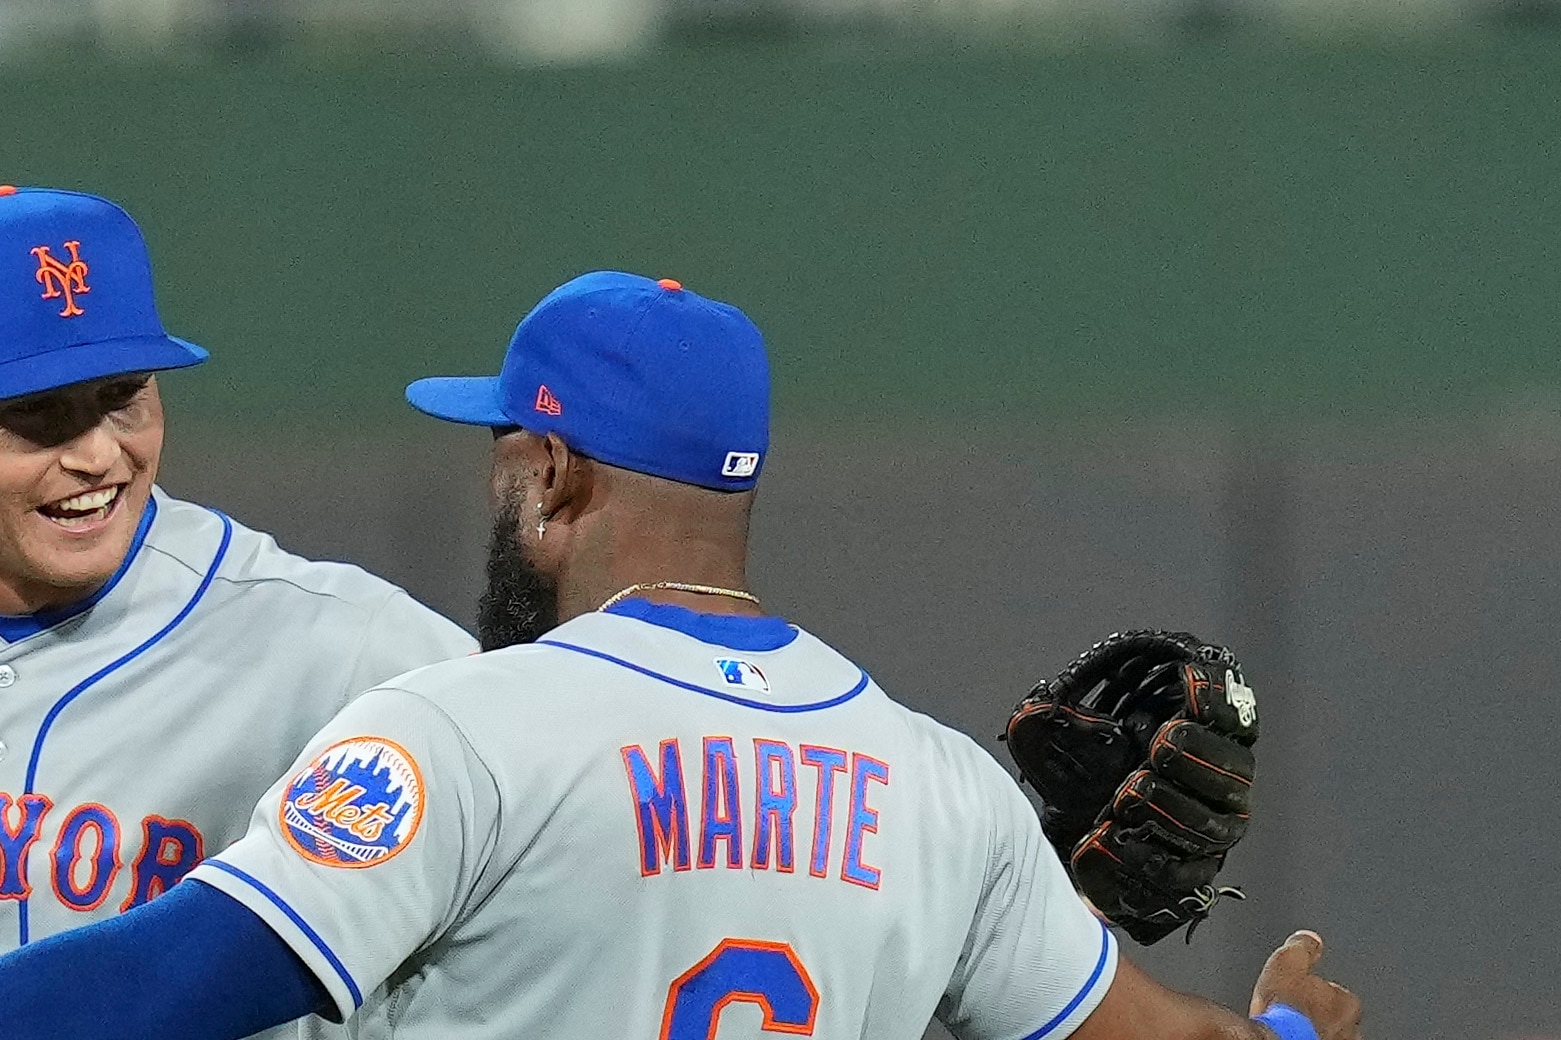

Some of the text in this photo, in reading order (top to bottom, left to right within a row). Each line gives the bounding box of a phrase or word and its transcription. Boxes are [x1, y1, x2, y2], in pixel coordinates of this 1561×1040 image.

[29, 240, 91, 318] NY
[295, 777, 394, 842] Mets
[621, 736, 890, 890] MARTE
